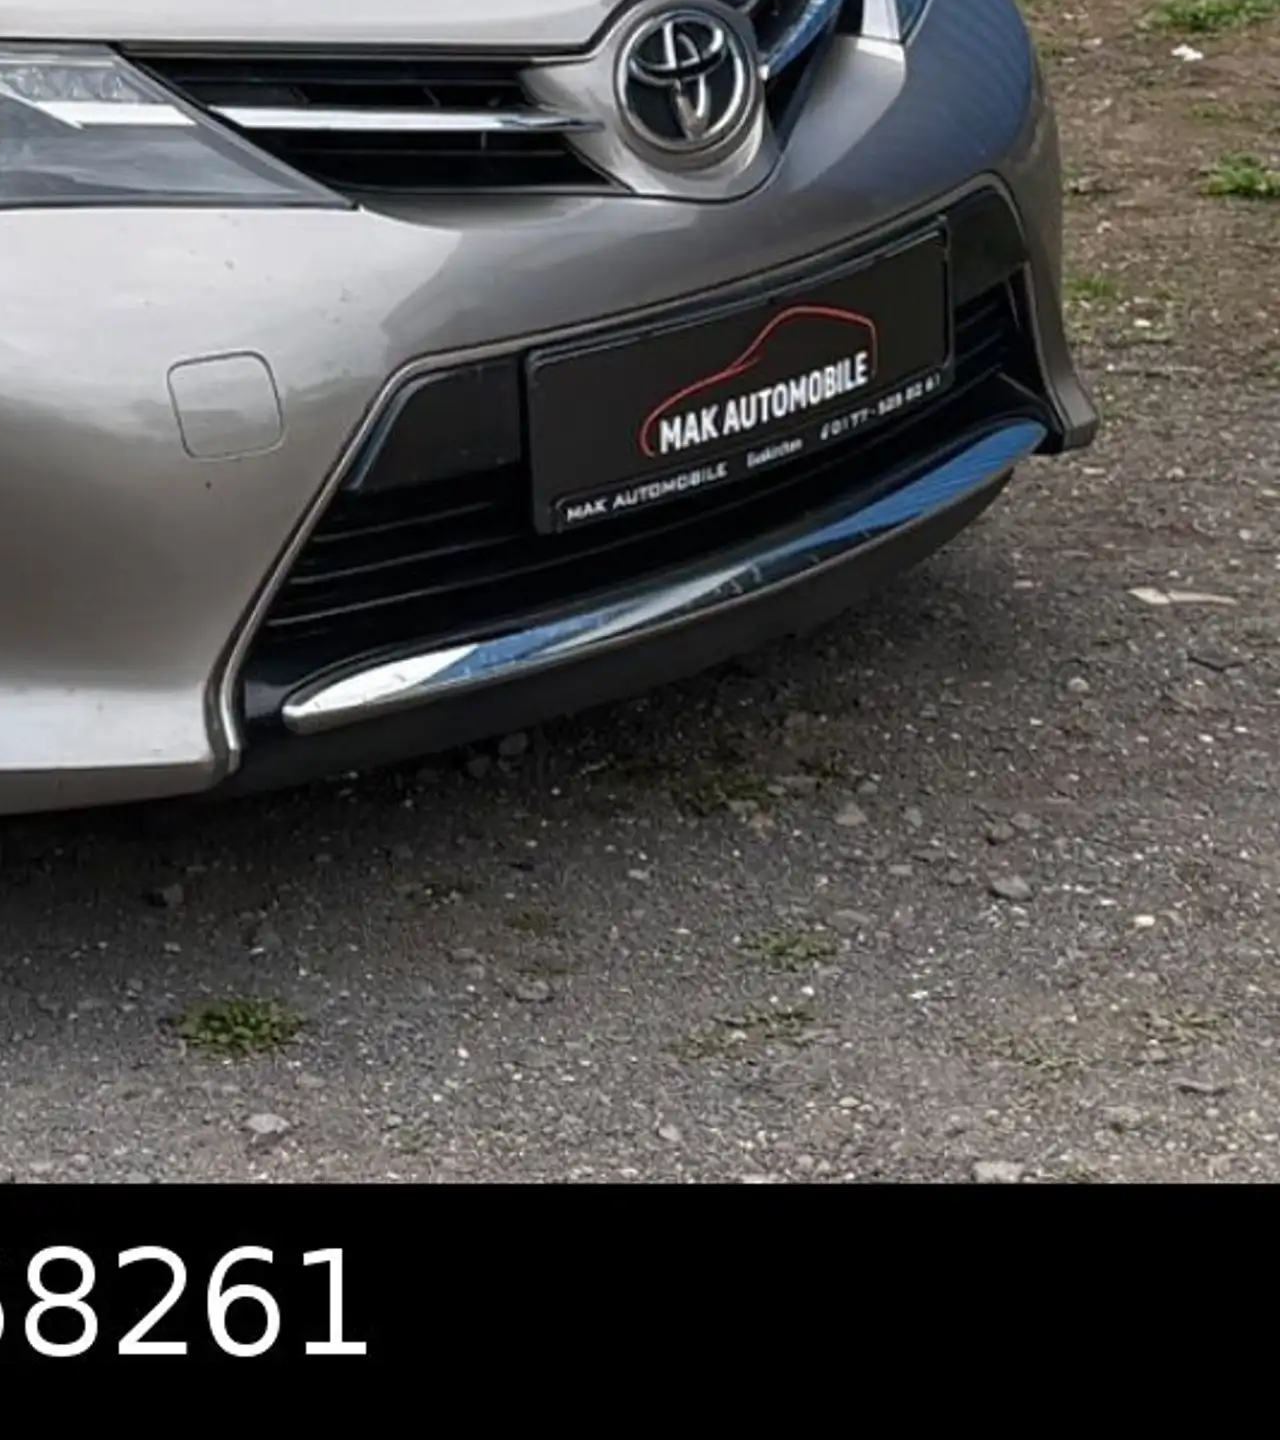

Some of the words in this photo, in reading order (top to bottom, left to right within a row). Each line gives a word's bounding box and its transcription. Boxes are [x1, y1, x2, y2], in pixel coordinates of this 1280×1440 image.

[659, 404, 720, 455] MAK
[722, 350, 870, 437] AUTOMOBILE
[566, 497, 608, 522] MAK
[611, 461, 729, 510] AUTOMOBILE
